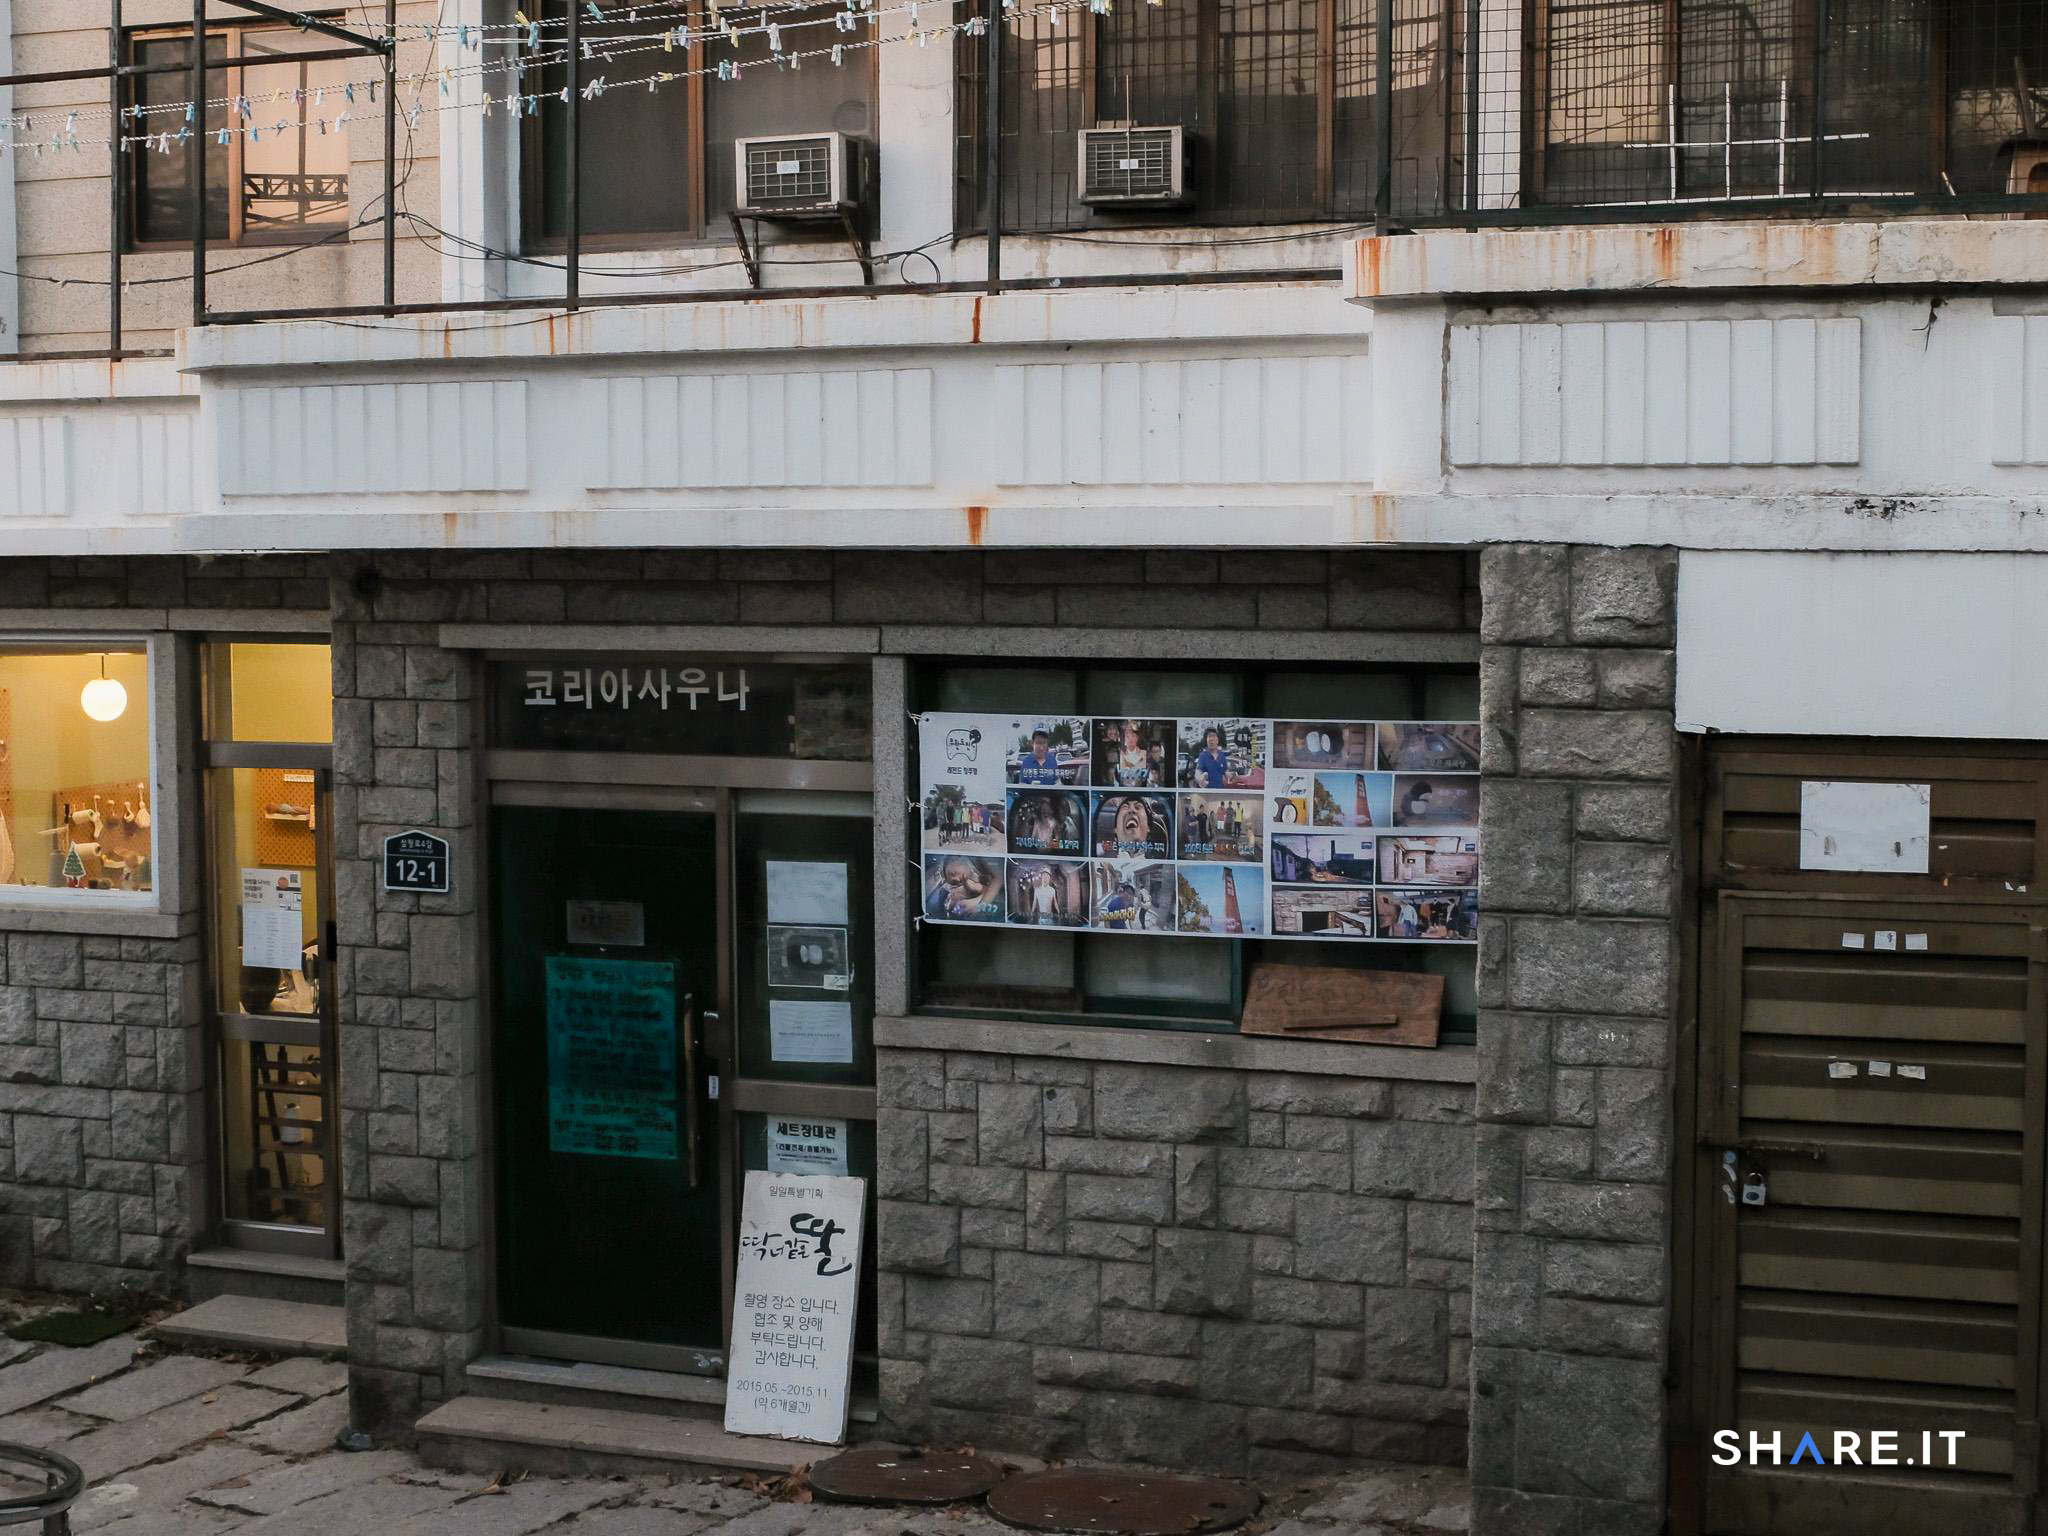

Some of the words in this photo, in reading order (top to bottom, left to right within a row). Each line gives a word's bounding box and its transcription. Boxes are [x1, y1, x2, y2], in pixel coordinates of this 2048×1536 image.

[524, 668, 750, 711] 코리아사우나
[395, 859, 436, 883] 12-1
[776, 1122, 837, 1140] 세트장대관
[769, 1185, 824, 1199] 일일특별기획
[744, 1293, 768, 1309] 촬영
[772, 1295, 796, 1310] 장소
[800, 1297, 840, 1316] 입니다.
[754, 1312, 778, 1328] 협조
[782, 1315, 795, 1330] 및
[799, 1316, 823, 1333] 양해
[750, 1331, 827, 1352] 부탁드립니다.
[755, 1350, 819, 1370] 감사합니다.
